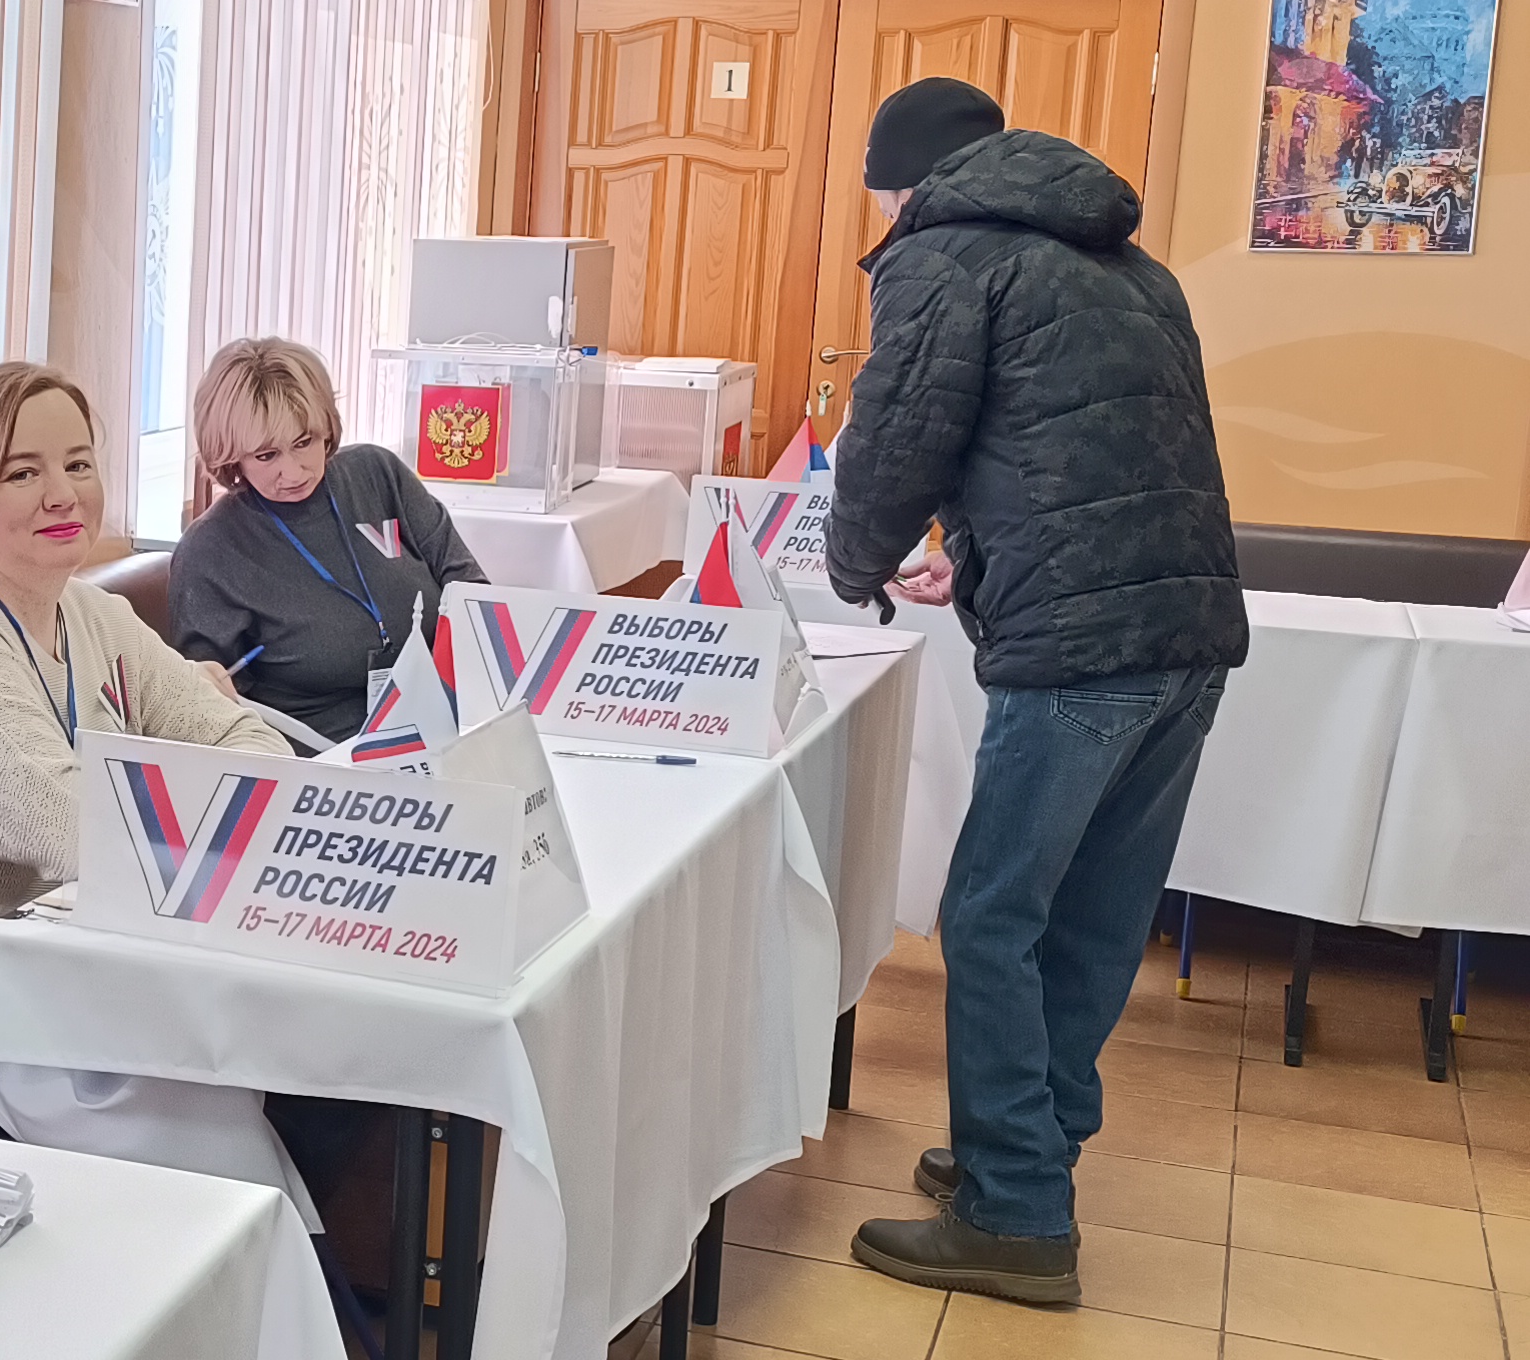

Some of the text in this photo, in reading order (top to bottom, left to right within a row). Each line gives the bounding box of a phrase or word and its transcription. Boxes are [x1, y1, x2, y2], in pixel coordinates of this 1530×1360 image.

[607, 613, 728, 644] ВЫБОРЫ
[591, 643, 760, 679] ПРЕЗИДЕНТА
[575, 672, 684, 702] РОССИИ
[616, 706, 681, 730] МАРТА
[682, 713, 730, 736] 2024
[292, 784, 454, 833] ВЫБОРЫ
[272, 825, 497, 885] ПРЕЗИДЕНТА
[253, 865, 396, 913] РОССИИ
[305, 916, 393, 953] МАРТА
[394, 930, 458, 964] 2024
